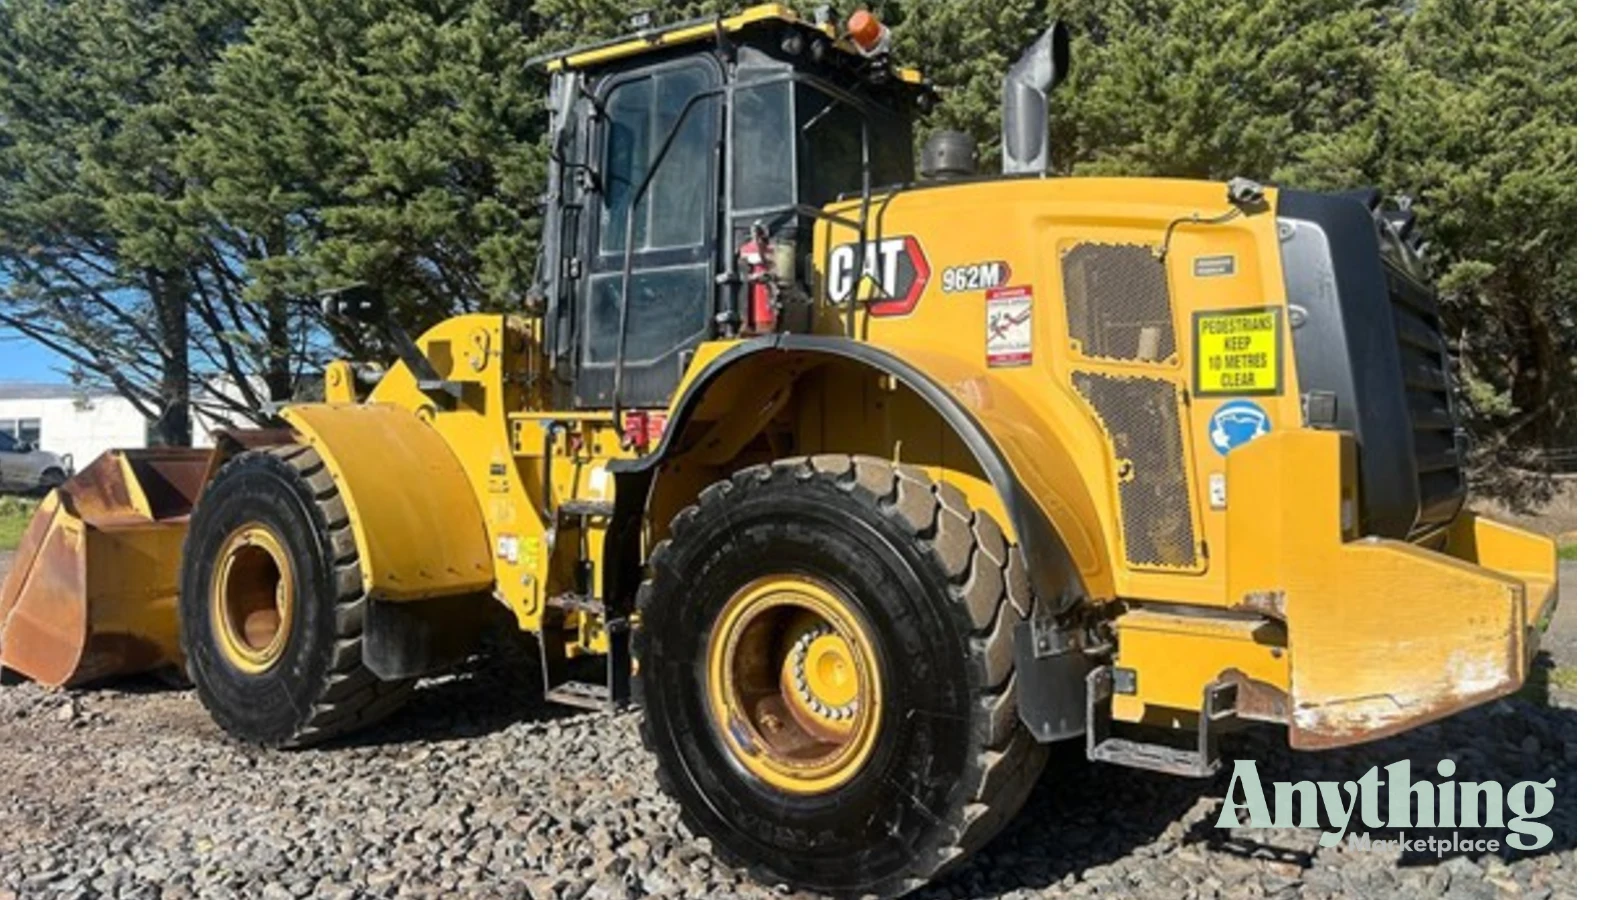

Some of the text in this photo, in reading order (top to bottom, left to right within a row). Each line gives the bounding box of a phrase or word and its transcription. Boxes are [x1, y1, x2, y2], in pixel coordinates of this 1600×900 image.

[828, 239, 905, 303] CAT
[942, 263, 999, 291] 962M
[1201, 315, 1273, 335] PEDESTRIANS
[1224, 336, 1252, 351] KEEP
[1209, 352, 1267, 371] 10 METRES
[1220, 372, 1255, 387] CLEAR
